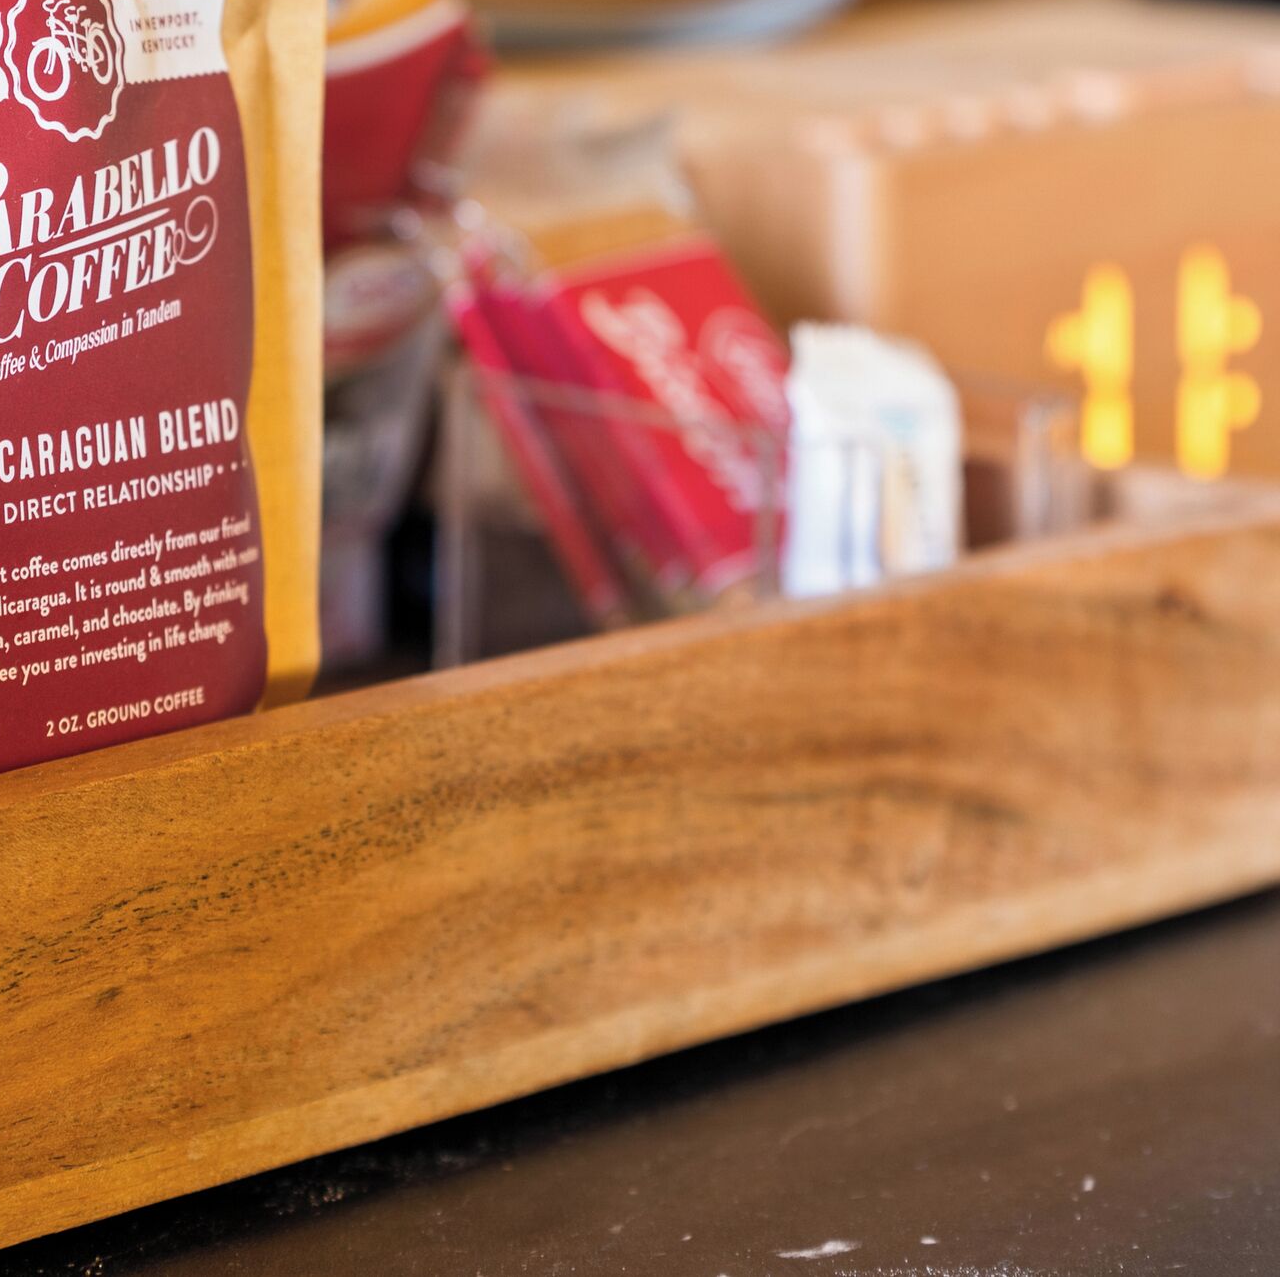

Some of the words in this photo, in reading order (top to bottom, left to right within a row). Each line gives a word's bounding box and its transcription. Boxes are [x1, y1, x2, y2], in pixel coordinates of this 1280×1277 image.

[129, 18, 142, 32] IN
[142, 35, 194, 54] KENTUCKY
[29, 345, 47, 371] &
[45, 320, 118, 364] Compassion
[121, 312, 134, 338] in
[136, 299, 182, 332] Tandem
[158, 398, 239, 454] BLEND
[3, 491, 77, 524] DIRECT
[83, 463, 213, 510] RELATIONSHIP
[11, 555, 59, 581] coffee
[62, 549, 108, 573] comes
[111, 533, 163, 562] directly
[165, 529, 197, 551] from
[199, 525, 219, 544] our
[75, 581, 87, 602] It
[90, 579, 102, 599] is
[105, 568, 146, 596] round
[149, 565, 162, 588] &
[164, 554, 211, 584] smooth
[213, 548, 237, 572] with
[14, 615, 79, 646] caramel,
[83, 608, 109, 633] and
[112, 598, 181, 627] chocolate.
[184, 589, 201, 617] By
[203, 580, 249, 606] drinking
[21, 660, 50, 686] you
[54, 654, 77, 671] are
[81, 636, 147, 663] investing
[148, 631, 162, 652] in
[164, 623, 185, 648] life
[188, 620, 234, 644] change.
[46, 720, 54, 737] 2
[58, 714, 83, 734] OZ.
[86, 700, 151, 728] GROUND
[154, 686, 205, 714] COFFEE
